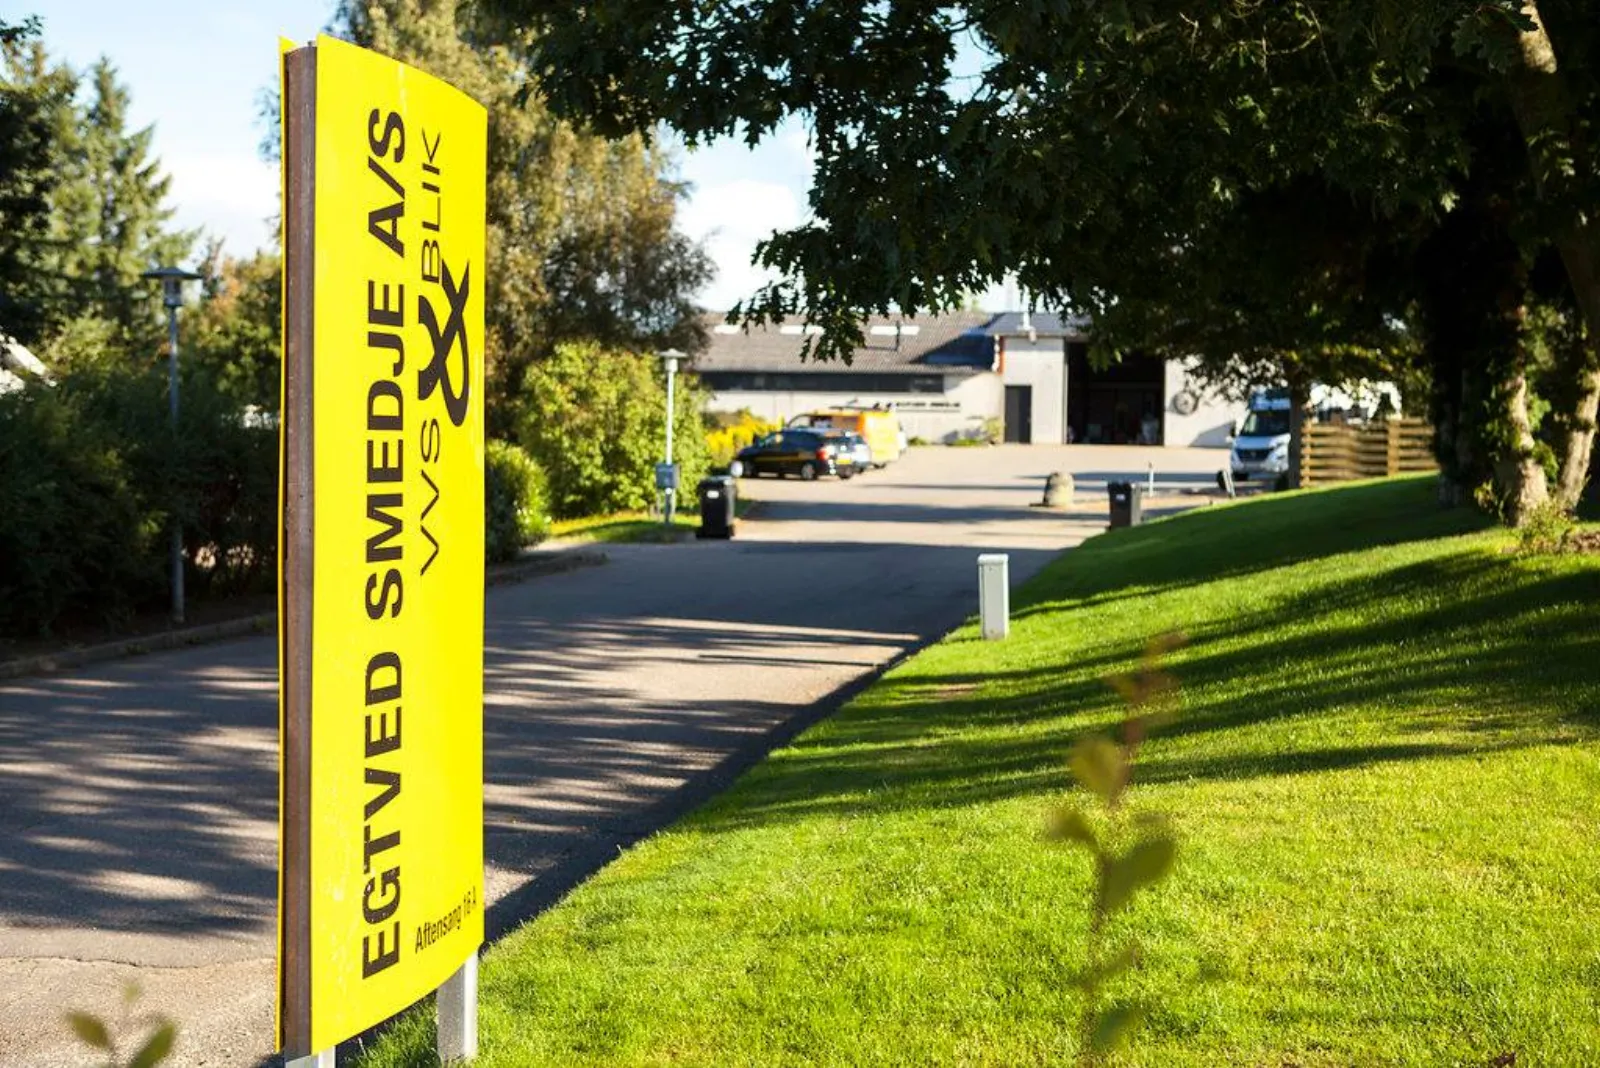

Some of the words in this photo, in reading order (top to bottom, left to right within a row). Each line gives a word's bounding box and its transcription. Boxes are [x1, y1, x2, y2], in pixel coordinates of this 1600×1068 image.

[367, 108, 406, 259] A/S
[421, 129, 440, 284] BLIK
[365, 281, 405, 620] SMEDJE
[419, 418, 440, 576] VVS
[362, 652, 402, 980] EGTVED
[414, 904, 462, 954] Aftensang
